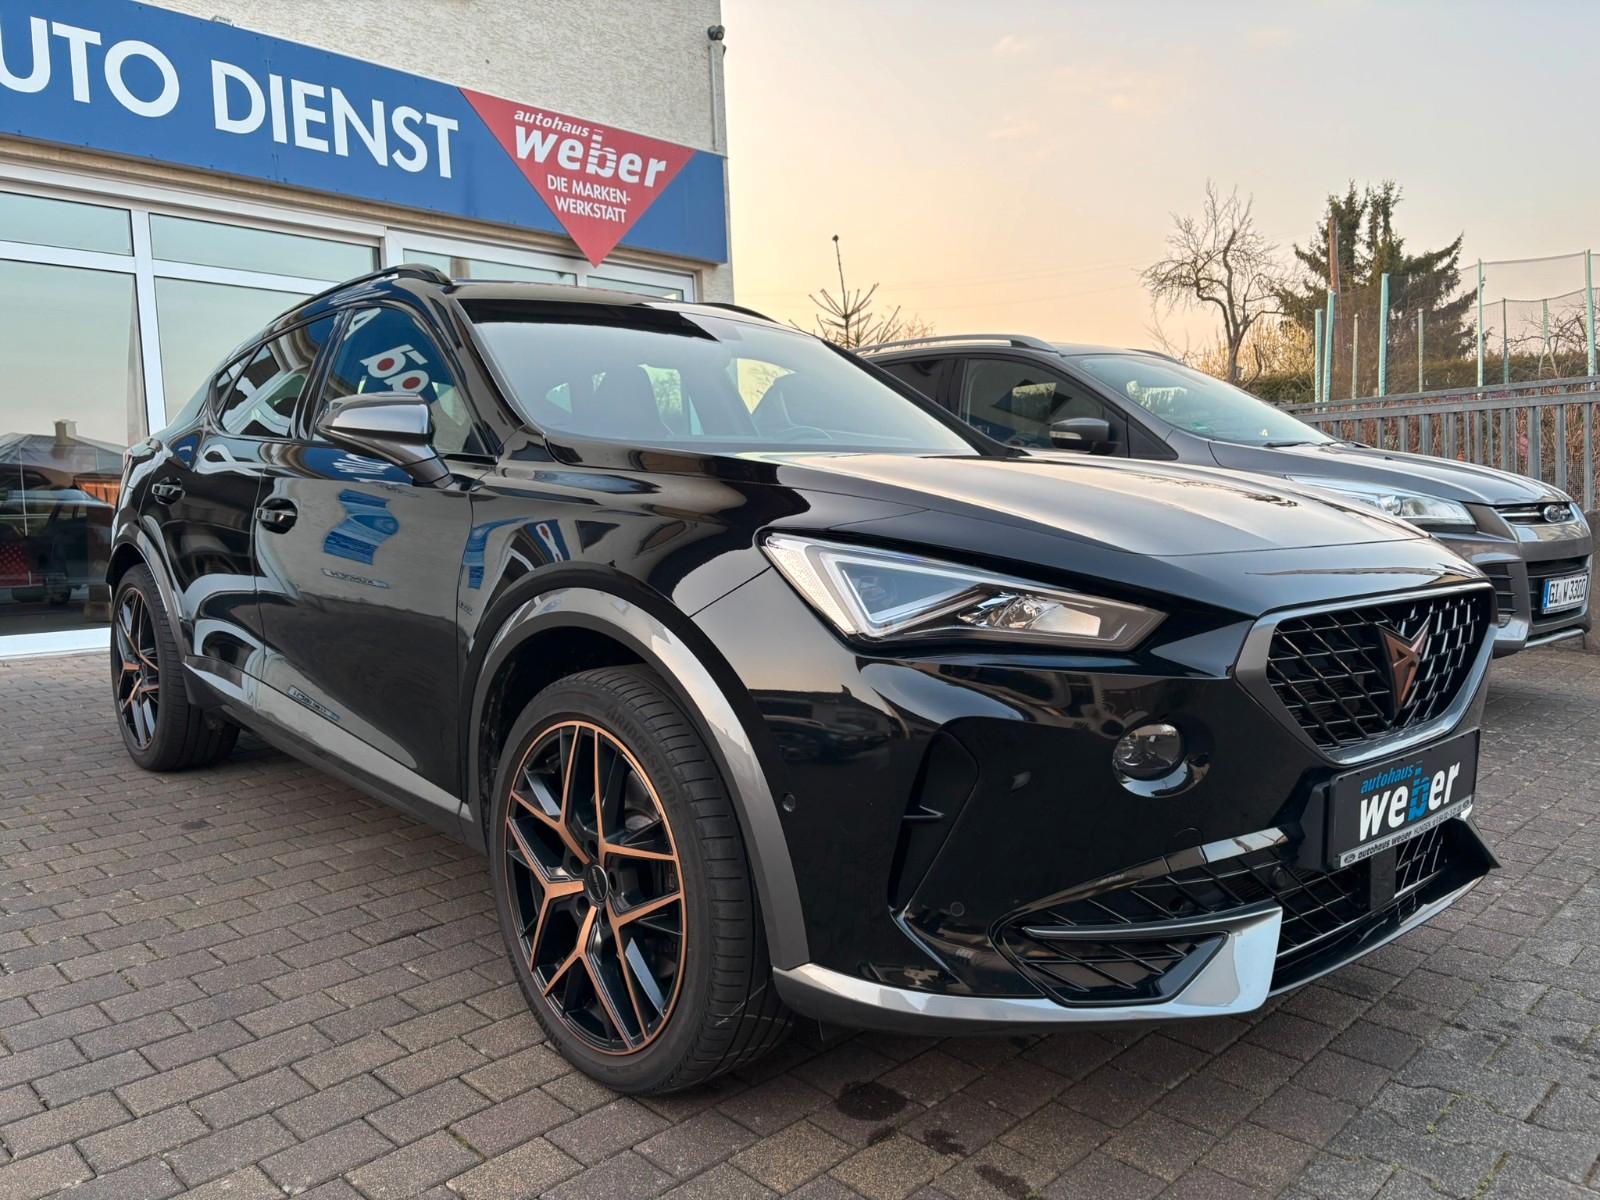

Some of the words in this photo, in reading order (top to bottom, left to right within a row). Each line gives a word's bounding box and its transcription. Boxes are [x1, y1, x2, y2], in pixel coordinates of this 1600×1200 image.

[210, 59, 459, 179] DIENST
[513, 109, 590, 138] autohaus
[515, 125, 667, 188] weber
[547, 174, 569, 194] DIE
[572, 180, 632, 205] MARKEN-
[555, 195, 627, 224] WERKSTATT
[1360, 764, 1414, 795] autohaus
[1359, 760, 1461, 842] weber
